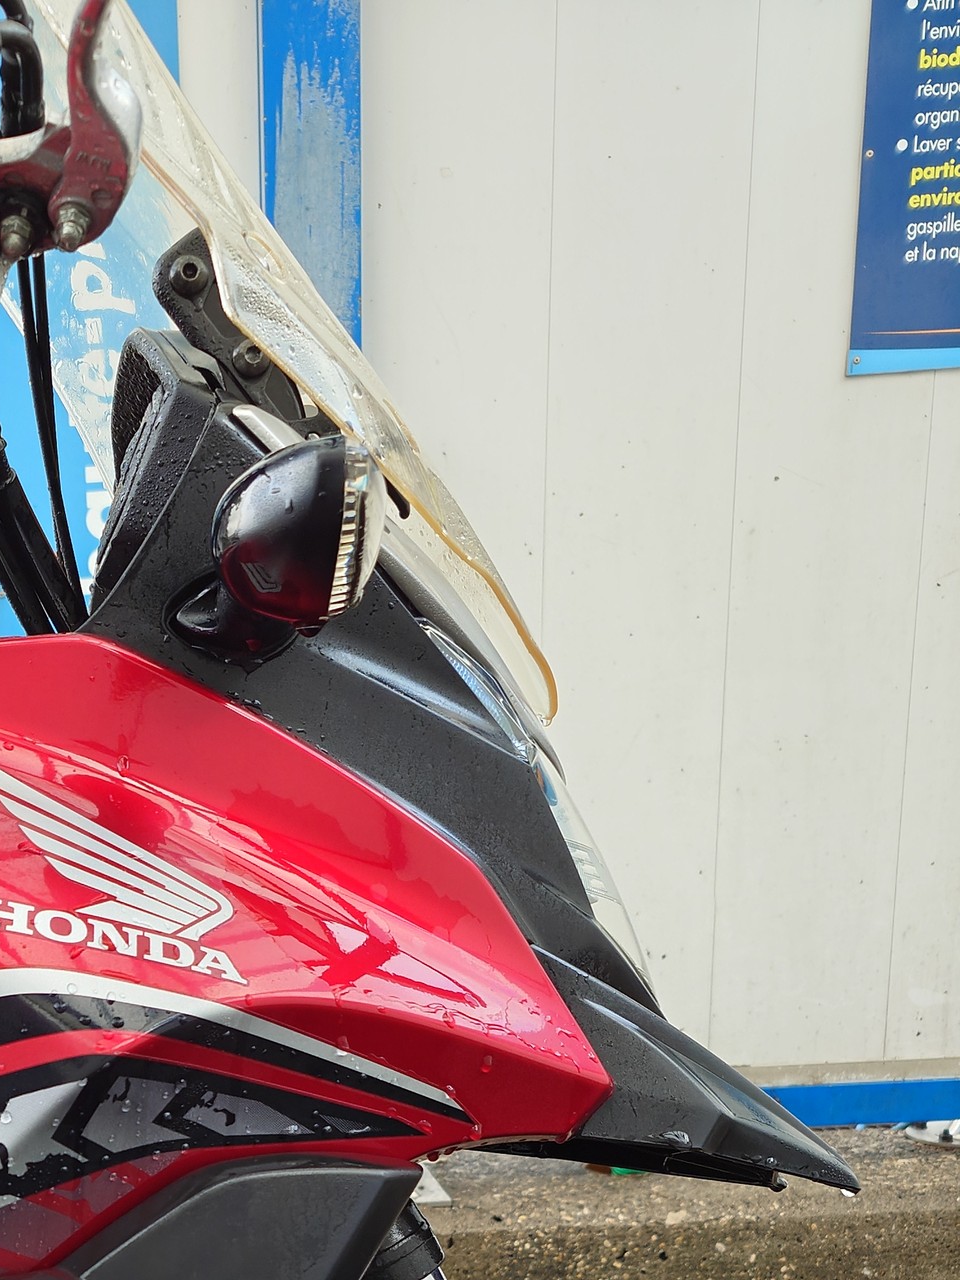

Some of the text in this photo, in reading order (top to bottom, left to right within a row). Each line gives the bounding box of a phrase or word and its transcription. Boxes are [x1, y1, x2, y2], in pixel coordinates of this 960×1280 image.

[913, 134, 953, 153] Laver
[905, 246, 919, 263] et
[922, 241, 936, 261] la
